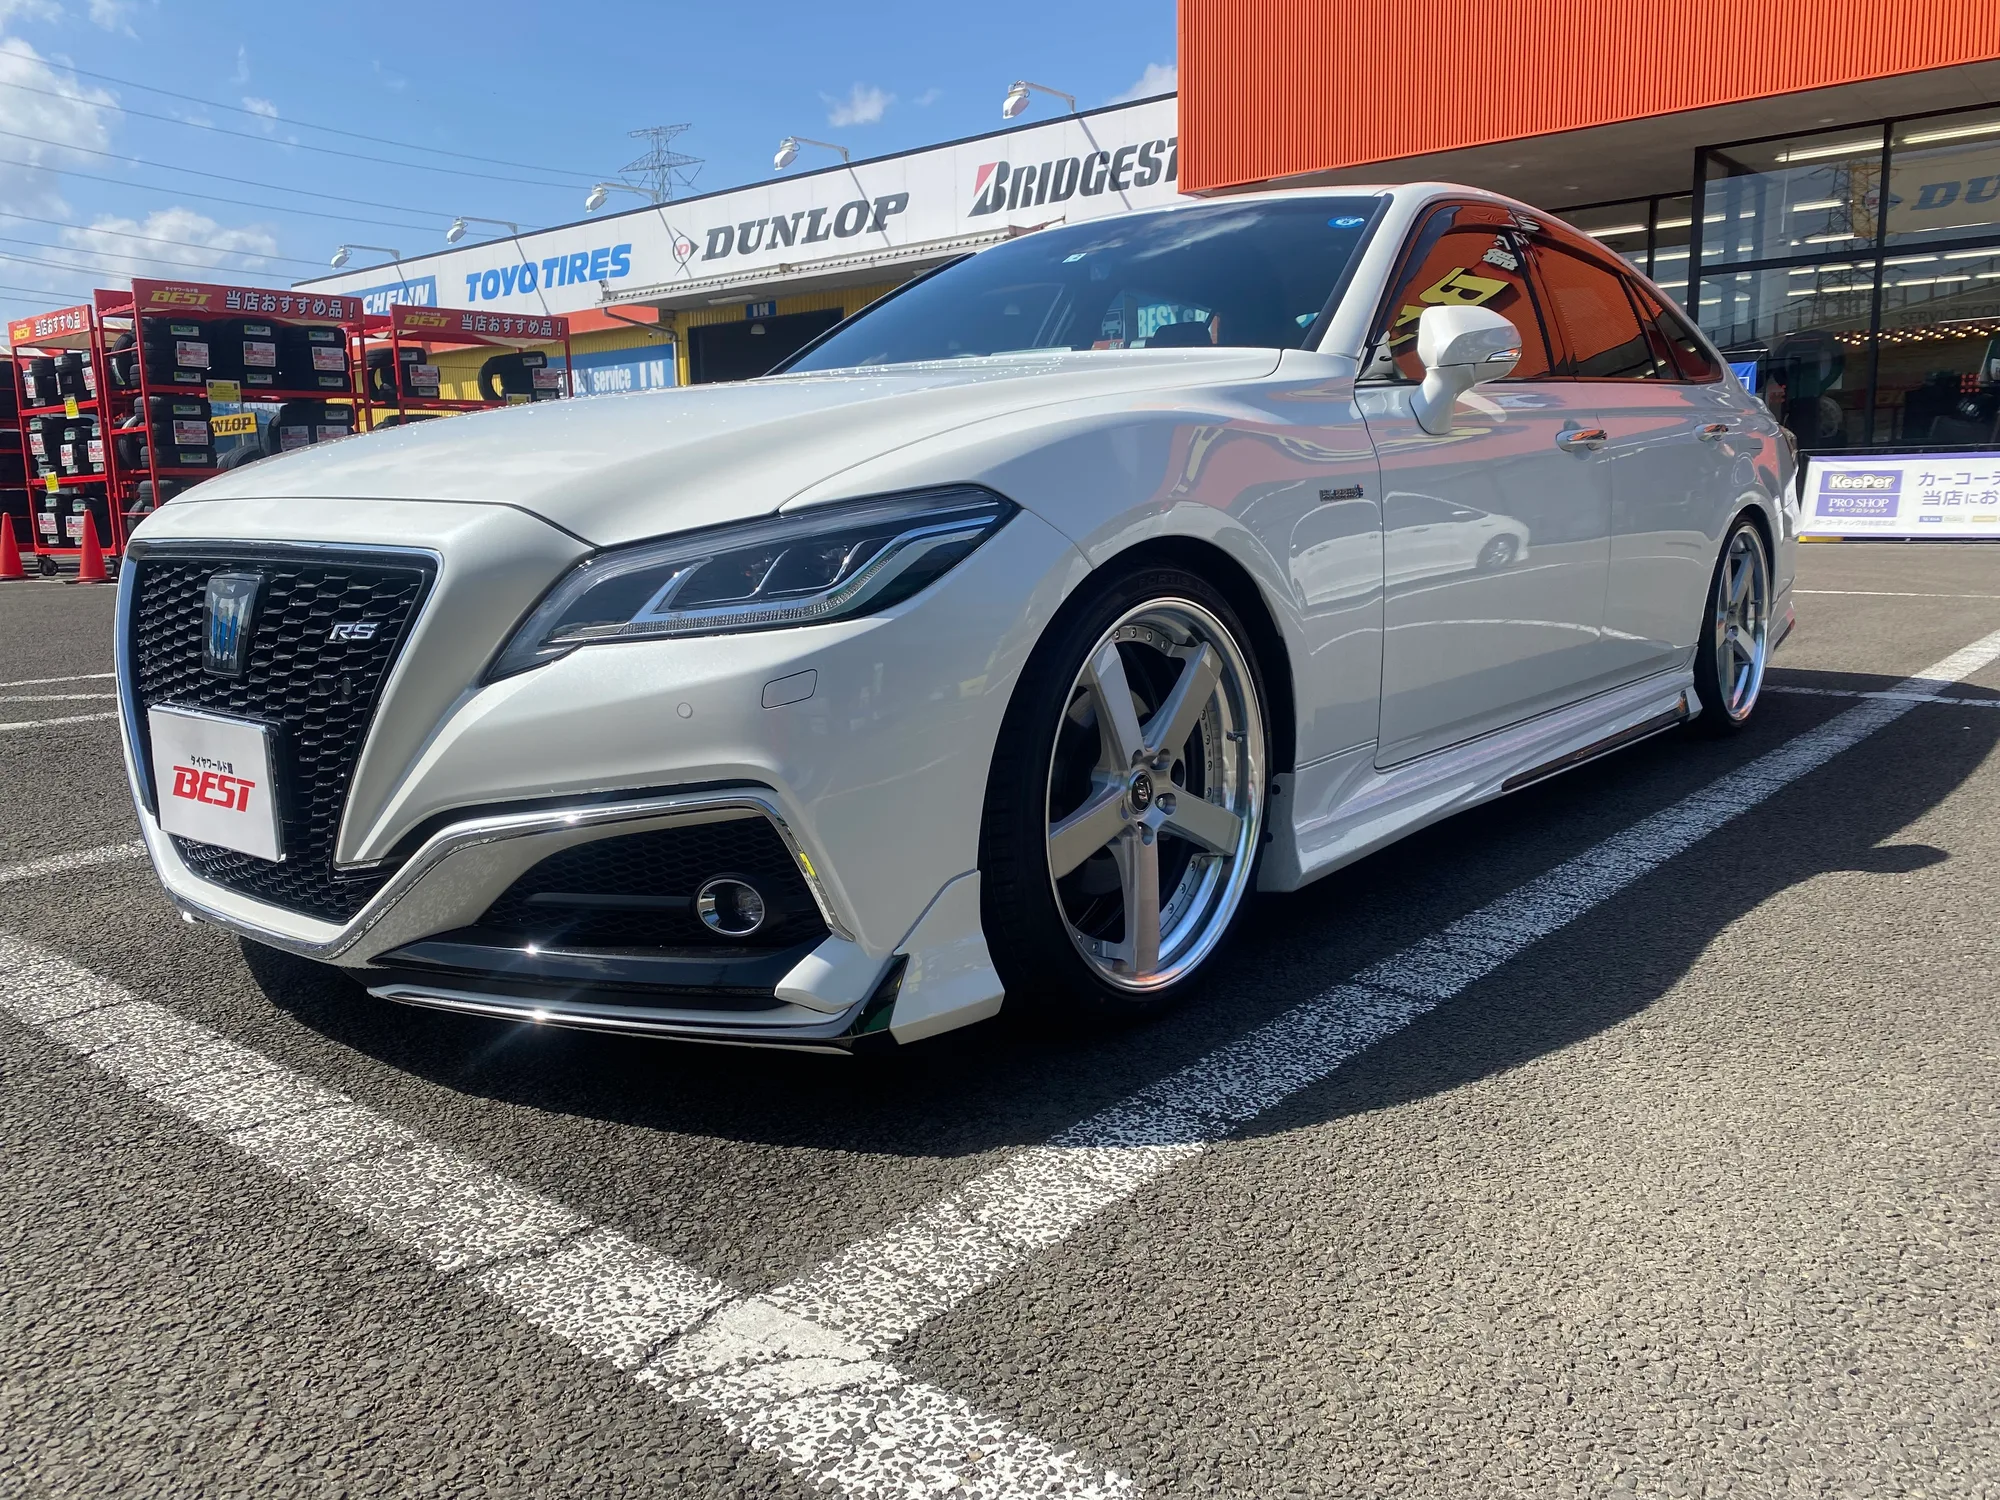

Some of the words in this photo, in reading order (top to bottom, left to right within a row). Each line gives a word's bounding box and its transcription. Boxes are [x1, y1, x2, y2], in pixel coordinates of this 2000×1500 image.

[701, 192, 910, 262] DUNLOP
[466, 262, 538, 302] TOYO
[542, 243, 632, 290] TIRES
[151, 290, 213, 305] BEST
[363, 283, 430, 315] CHELIN
[752, 303, 770, 317] IN
[404, 314, 452, 328] BEST
[593, 365, 631, 392] service
[639, 361, 665, 388] IN
[212, 416, 251, 433] NLOP
[1829, 474, 1895, 489] KeePer
[1828, 498, 1854, 508] PRO
[1855, 498, 1889, 508] SHOP
[329, 621, 377, 640] RS
[173, 765, 255, 812] BEST
